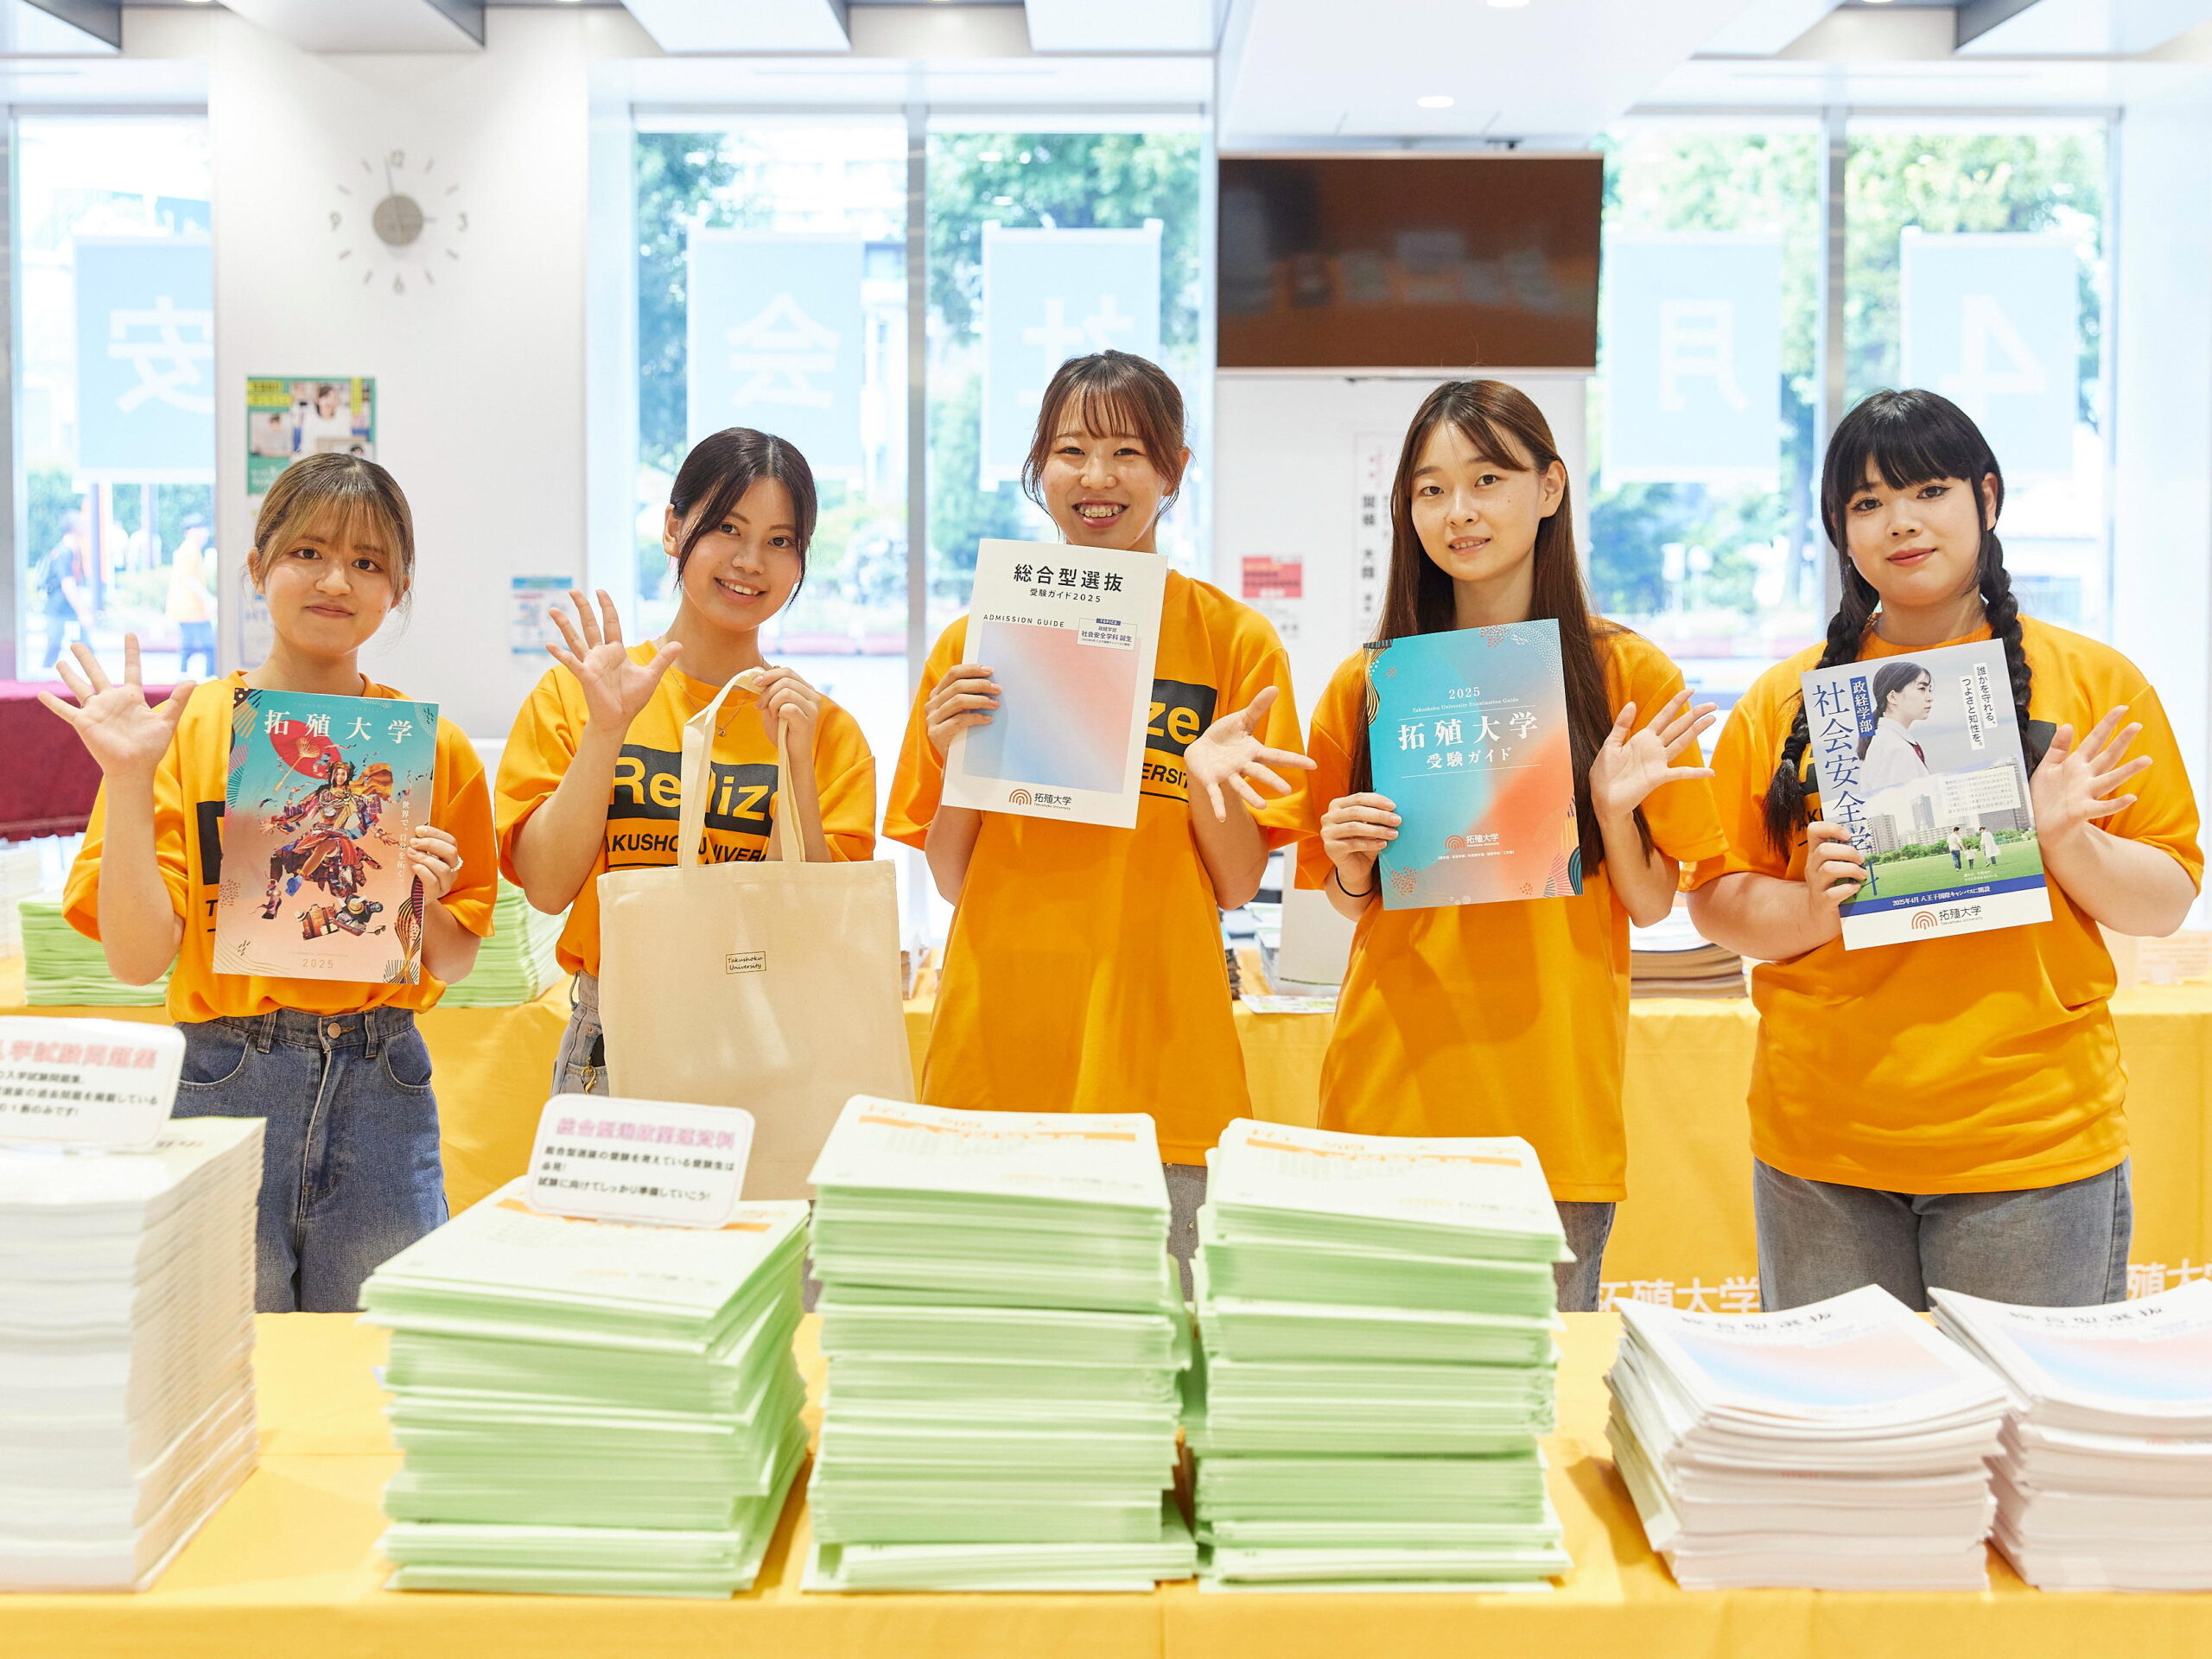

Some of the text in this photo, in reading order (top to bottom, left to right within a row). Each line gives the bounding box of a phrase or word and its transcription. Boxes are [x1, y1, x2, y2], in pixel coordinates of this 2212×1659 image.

[458, 213, 468, 232] 3
[393, 274, 404, 295] 6
[1014, 563, 1124, 593] 総合型選抜
[1029, 588, 1102, 603] 受験ガイド2025
[983, 613, 1065, 628] ADMISSION GUIDE
[1081, 630, 1119, 641] 社会安全学科
[1448, 686, 1481, 700] 2025
[1976, 665, 1997, 727] 誰かを守れる、
[1412, 705, 1440, 714] Takushoku
[1440, 702, 1468, 711] University
[1469, 699, 1502, 708] Examination
[1852, 680, 1874, 734] 政経学部
[1962, 677, 1984, 748] つよさと知性を。
[264, 709, 414, 745] 拓殖大学
[1397, 711, 1538, 751] 拓殖大学
[1426, 747, 1512, 771] 受験ガイド
[1034, 792, 1072, 806] 拓殖大学
[1465, 833, 1499, 844] 拓殖大学
[1939, 905, 1982, 921] 拓殖大学
[302, 958, 334, 969] 2025
[729, 963, 762, 971] University
